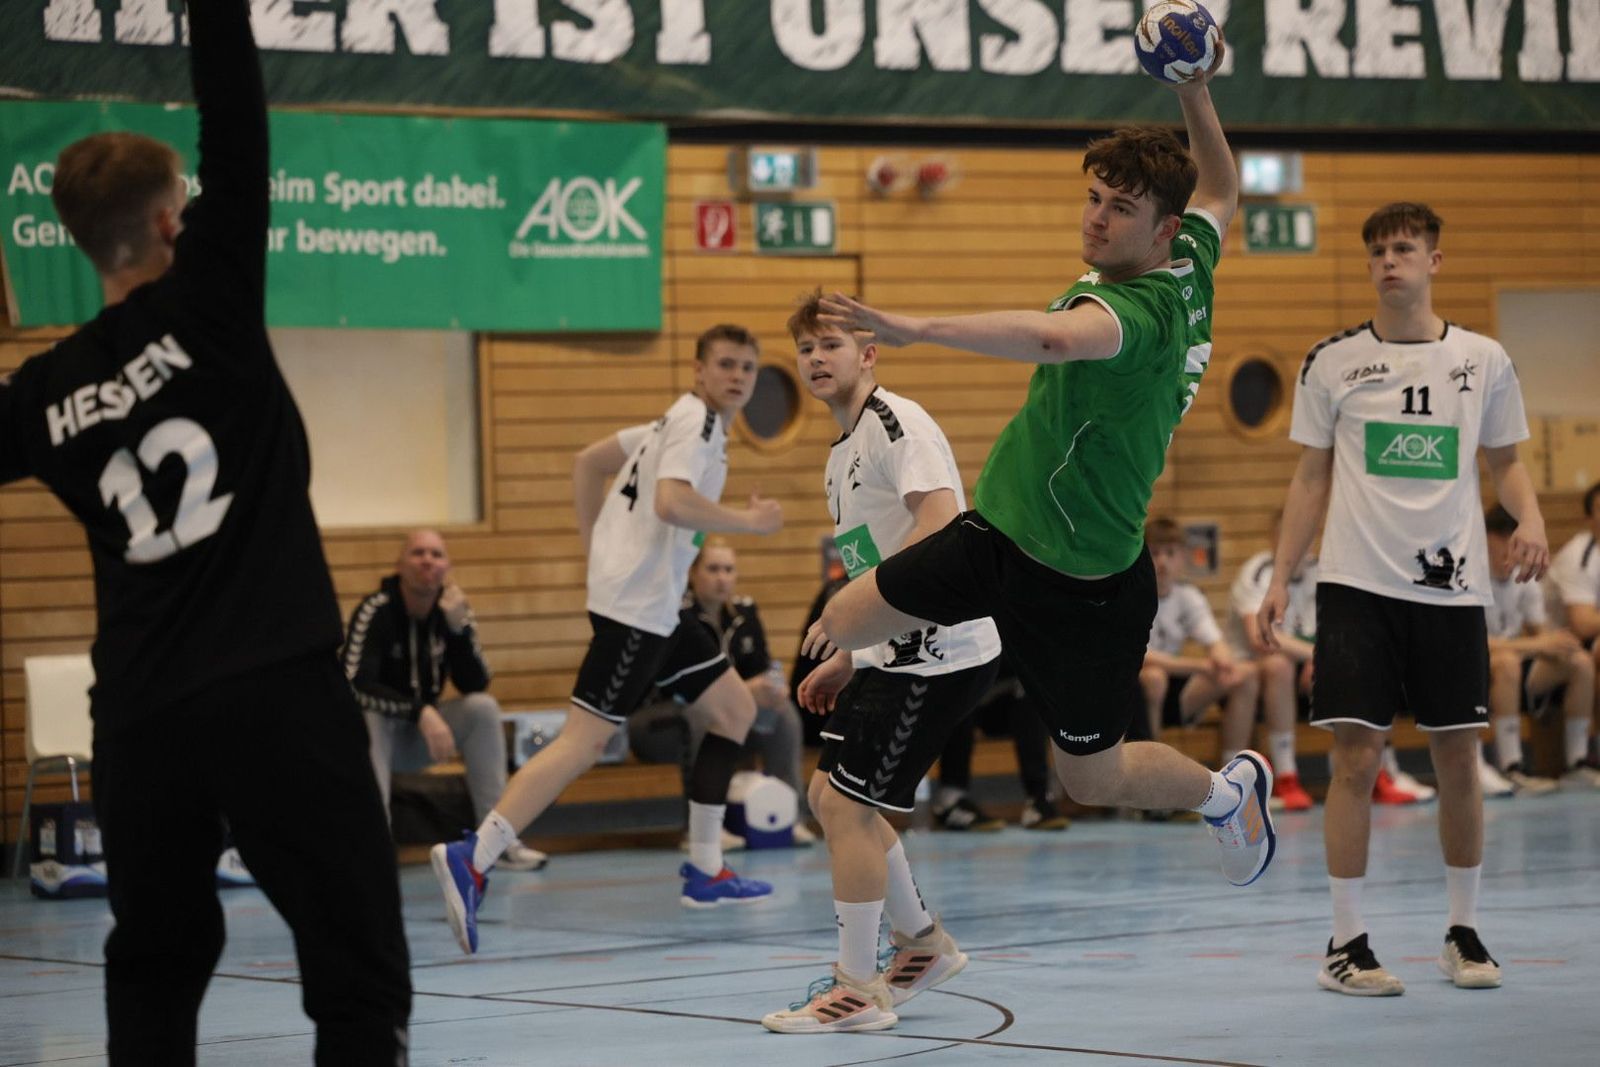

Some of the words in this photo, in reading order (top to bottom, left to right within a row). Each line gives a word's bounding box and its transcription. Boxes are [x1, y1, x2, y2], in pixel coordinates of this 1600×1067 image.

[323, 170, 407, 212] Sport
[413, 172, 506, 208] dabei.
[515, 175, 648, 242] AOK
[296, 218, 448, 264] bewegen.
[1401, 385, 1433, 416] 11
[1380, 432, 1445, 461] AOK
[97, 416, 235, 565] 12
[840, 539, 867, 570] OK
